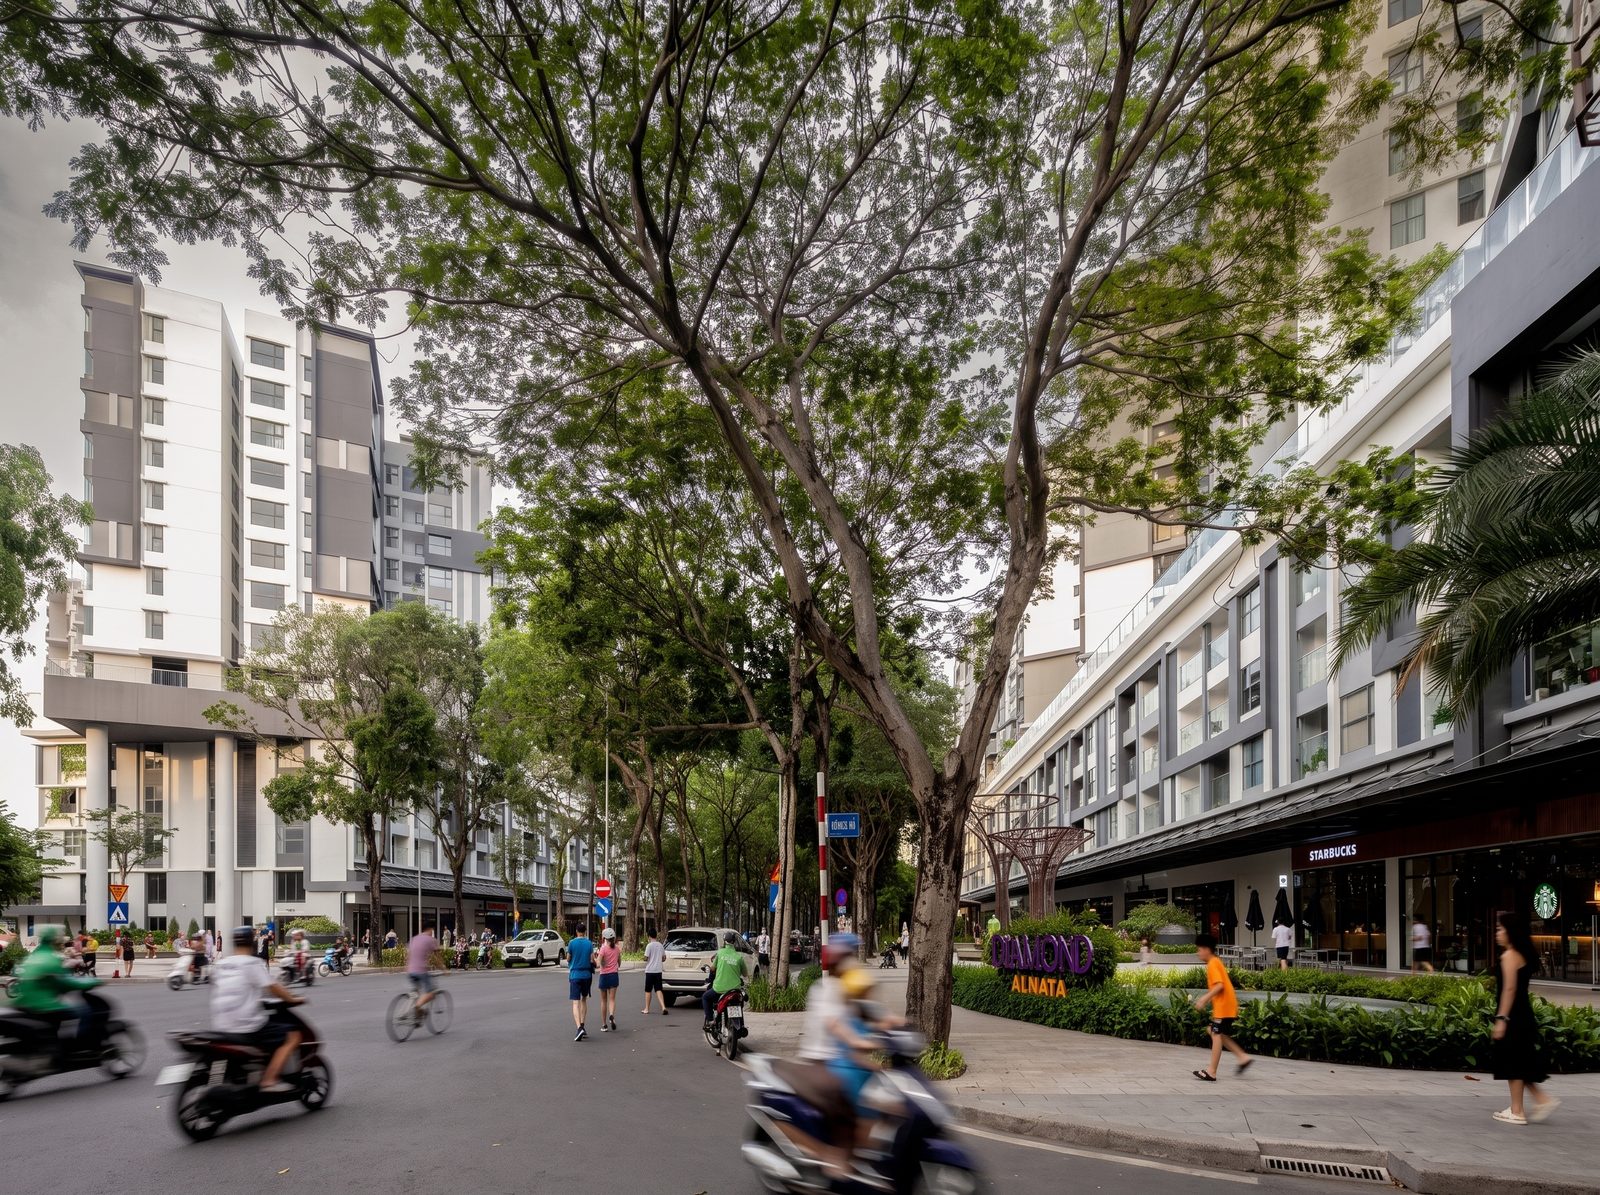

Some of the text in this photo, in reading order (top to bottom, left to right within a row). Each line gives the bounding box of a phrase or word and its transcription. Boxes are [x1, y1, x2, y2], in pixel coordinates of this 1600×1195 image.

[1309, 844, 1357, 861] STARBUCKS
[991, 934, 1094, 975] DIAMOND
[1011, 975, 1067, 998] ALNATA
